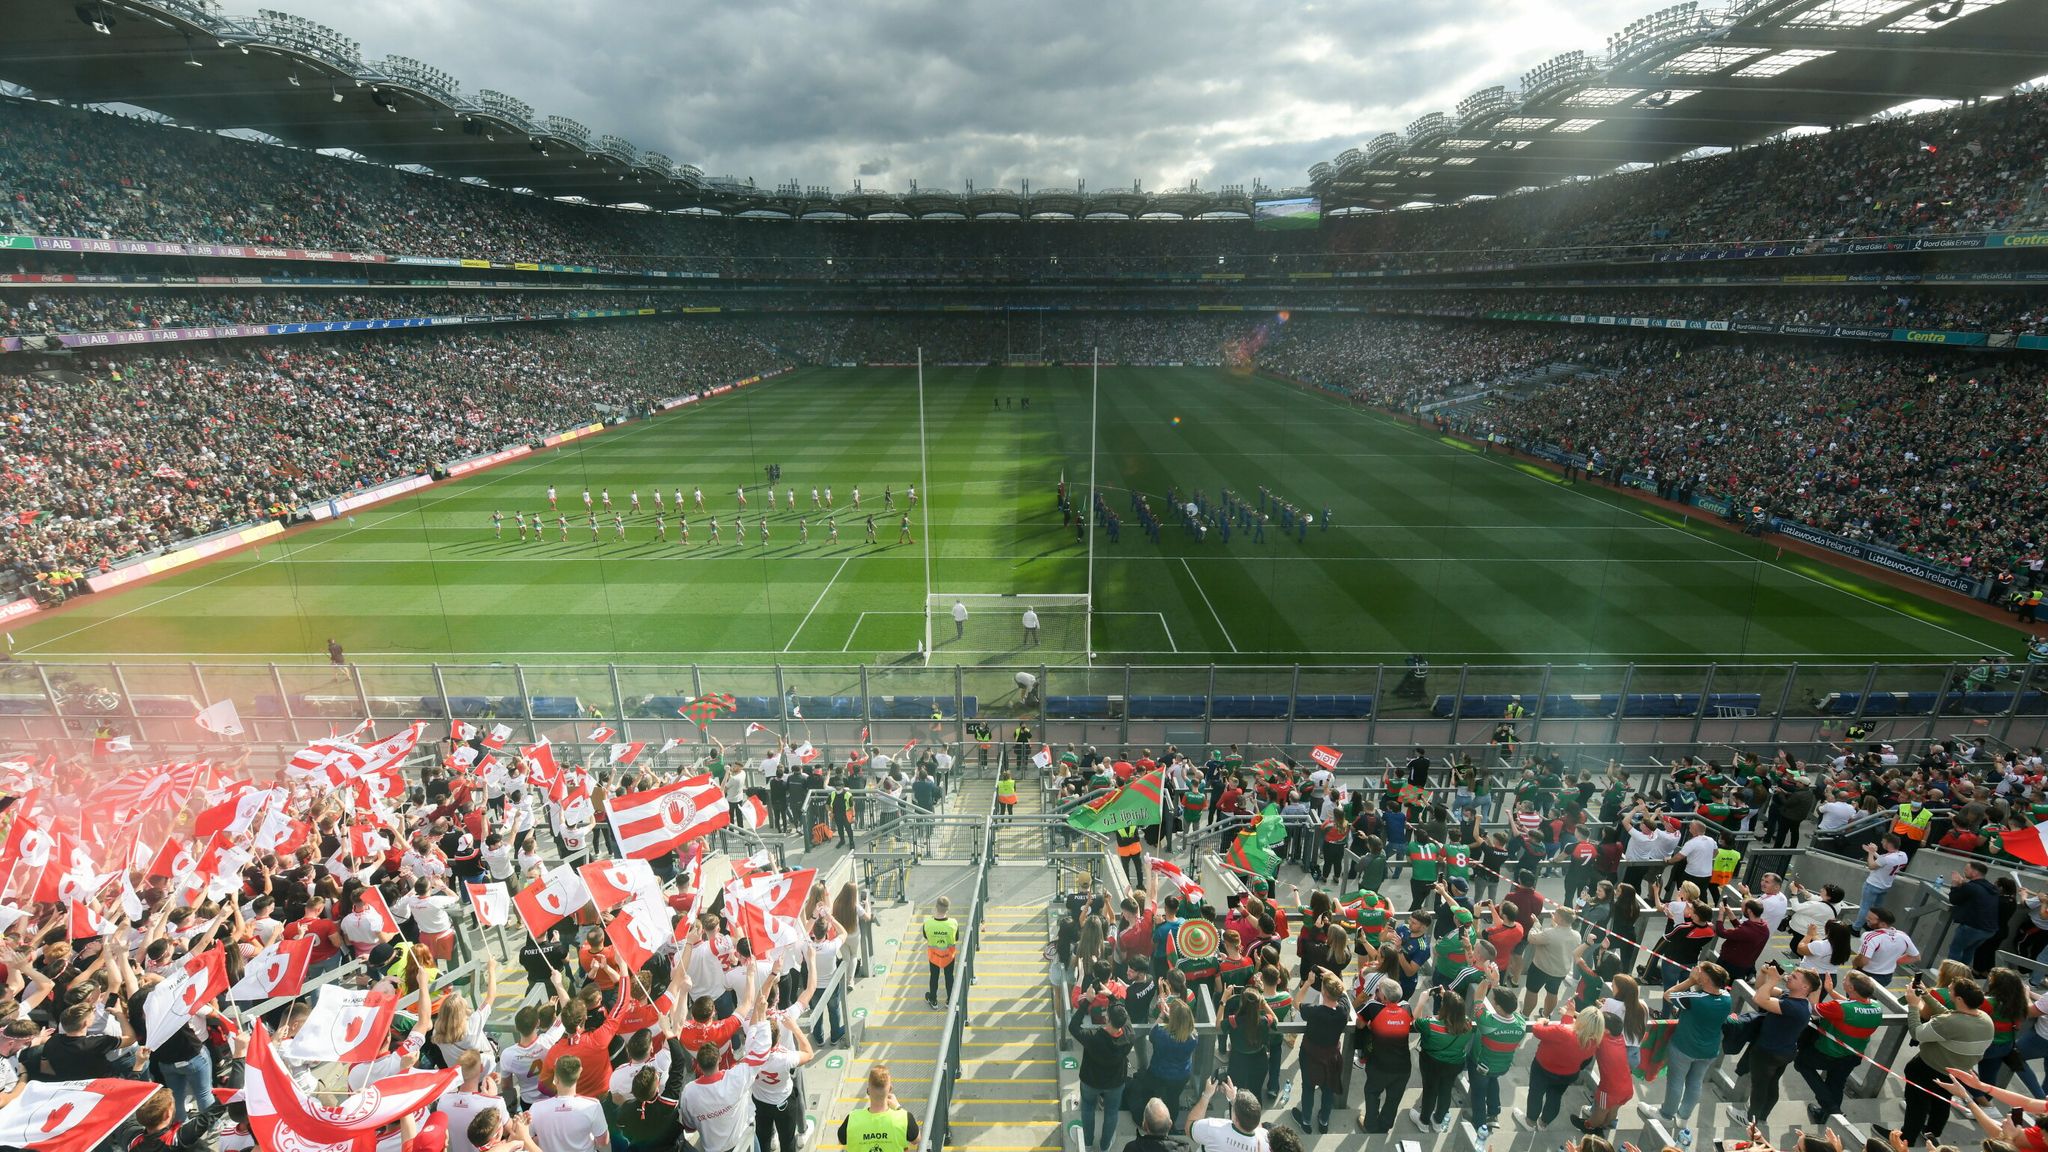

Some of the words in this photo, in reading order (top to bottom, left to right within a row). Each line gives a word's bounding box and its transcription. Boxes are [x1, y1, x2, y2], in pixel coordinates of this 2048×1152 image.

[52, 240, 72, 249] AIB
[93, 242, 111, 251] AIB
[1923, 240, 1939, 248] Bord
[1940, 238, 1955, 247] Gáis
[1955, 238, 1980, 248] Energy
[130, 244, 148, 253] AIB
[165, 245, 180, 254] AIB
[198, 246, 212, 255] AIB
[227, 248, 241, 256] AIB
[162, 330, 178, 340] AIB
[194, 330, 209, 338] AIB
[224, 328, 238, 336] AIB
[1842, 328, 1855, 336] Bord
[1868, 329, 1890, 338] Energy
[1907, 331, 1946, 342] Centra
[90, 335, 108, 344] AIB
[128, 333, 144, 342] AIB
[1698, 500, 1727, 515] Centra
[1780, 524, 1825, 545] Littlewoods
[1826, 538, 1860, 557] Ireland.ie
[1868, 552, 1924, 577] Littlewoods
[1925, 571, 1968, 592] Ireland.ie
[564, 837, 579, 848] 19
[1418, 844, 1433, 860] 11
[1456, 852, 1466, 868] 8
[1580, 853, 1593, 866] 7
[863, 1132, 888, 1140] MAOR
